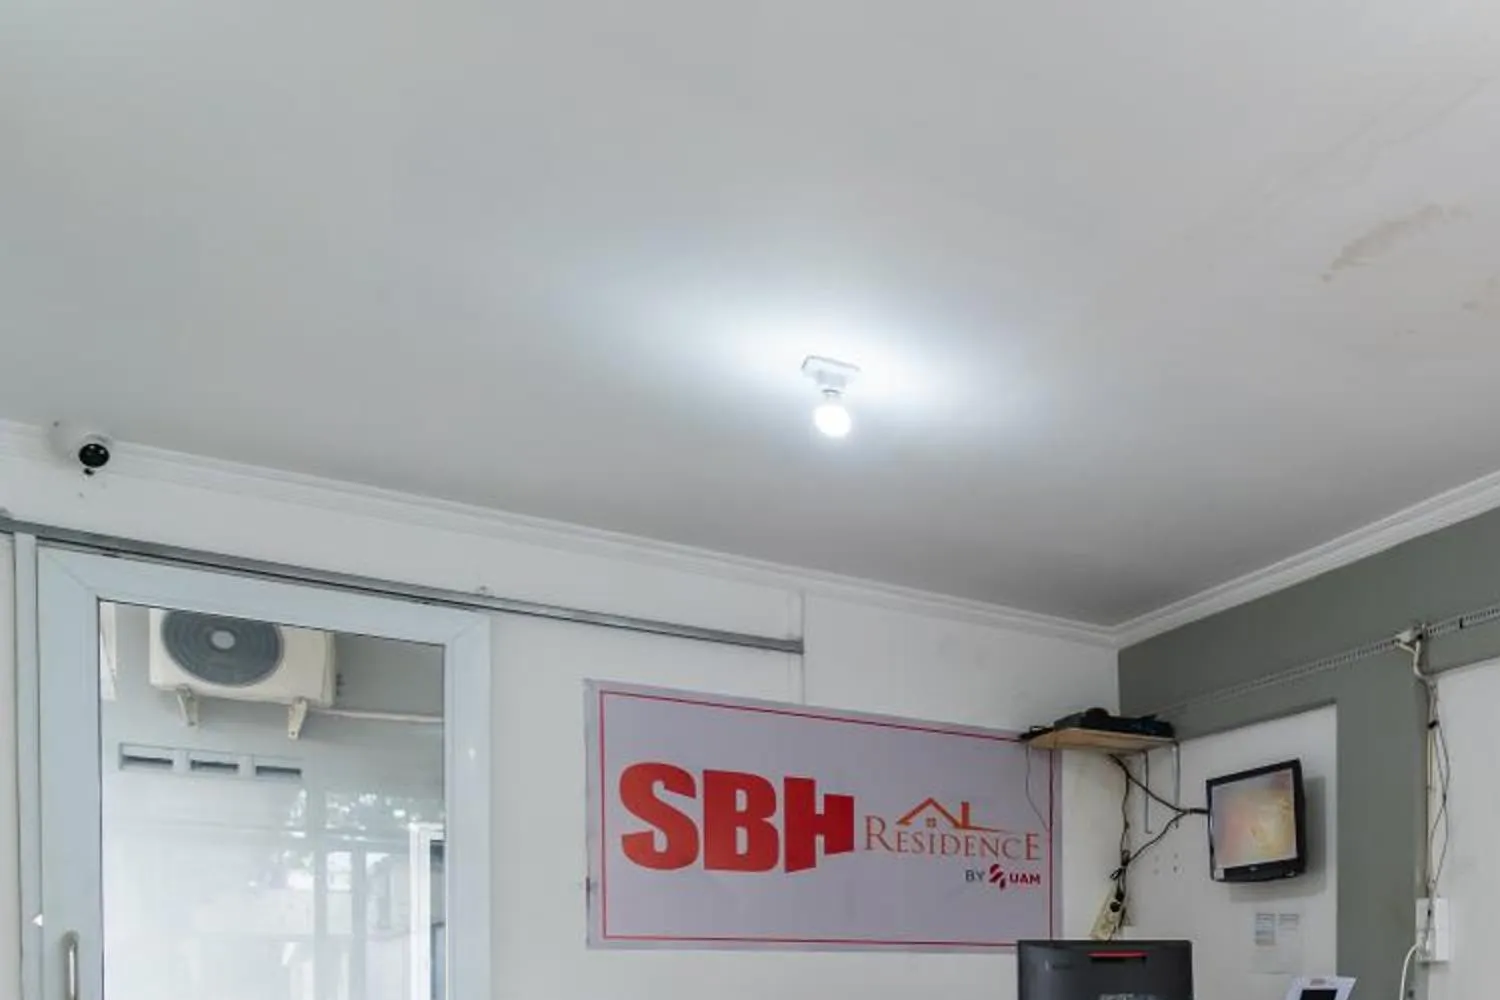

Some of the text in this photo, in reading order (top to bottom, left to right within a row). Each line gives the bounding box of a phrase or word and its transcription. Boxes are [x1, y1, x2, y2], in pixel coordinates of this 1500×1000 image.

[619, 761, 1042, 873] SBH RESIDENCE
[965, 869, 985, 883] BY
